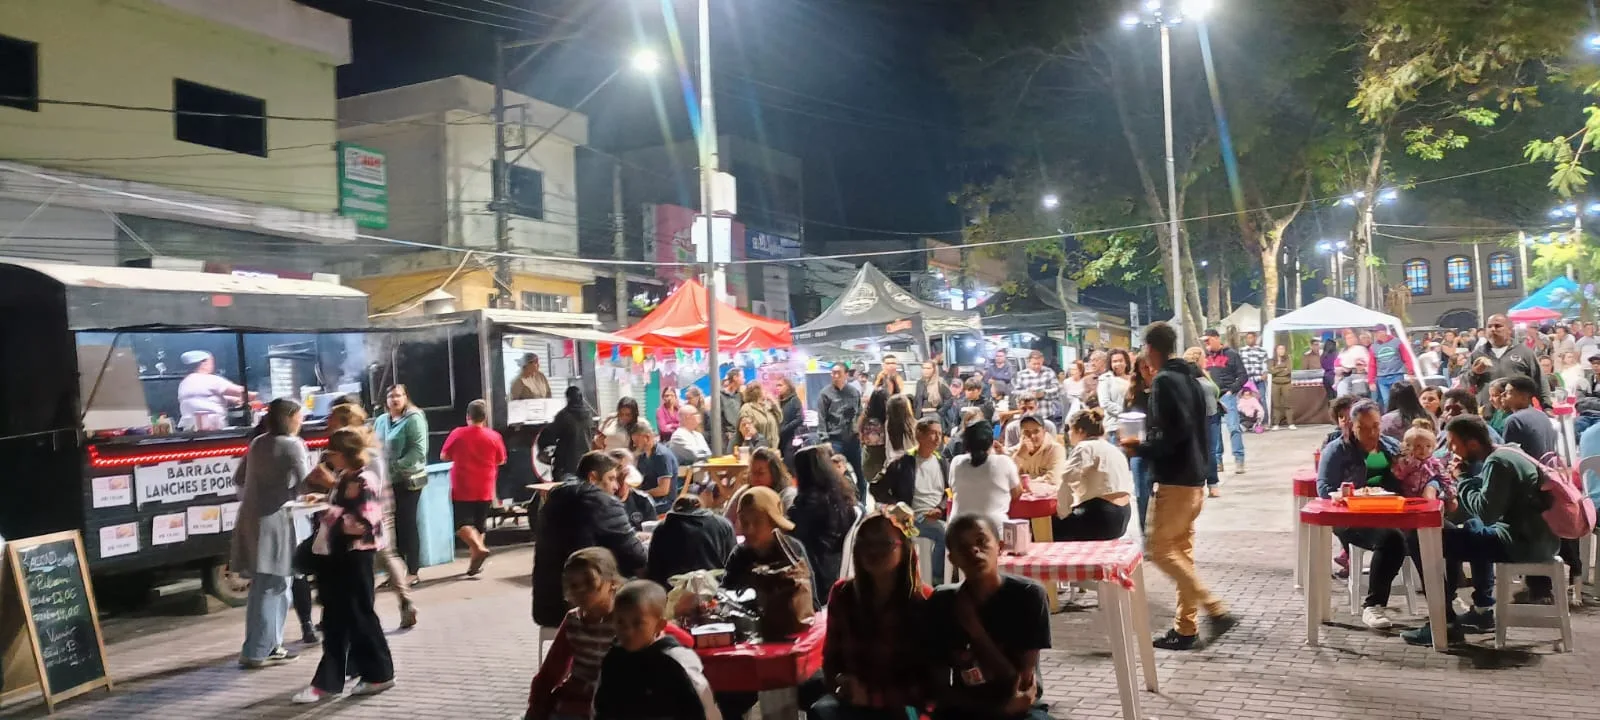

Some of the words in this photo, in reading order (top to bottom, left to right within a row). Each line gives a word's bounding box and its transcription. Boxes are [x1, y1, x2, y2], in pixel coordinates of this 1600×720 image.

[167, 462, 231, 479] BARRACA
[145, 479, 198, 498] LANCHES
[201, 478, 207, 491] E
